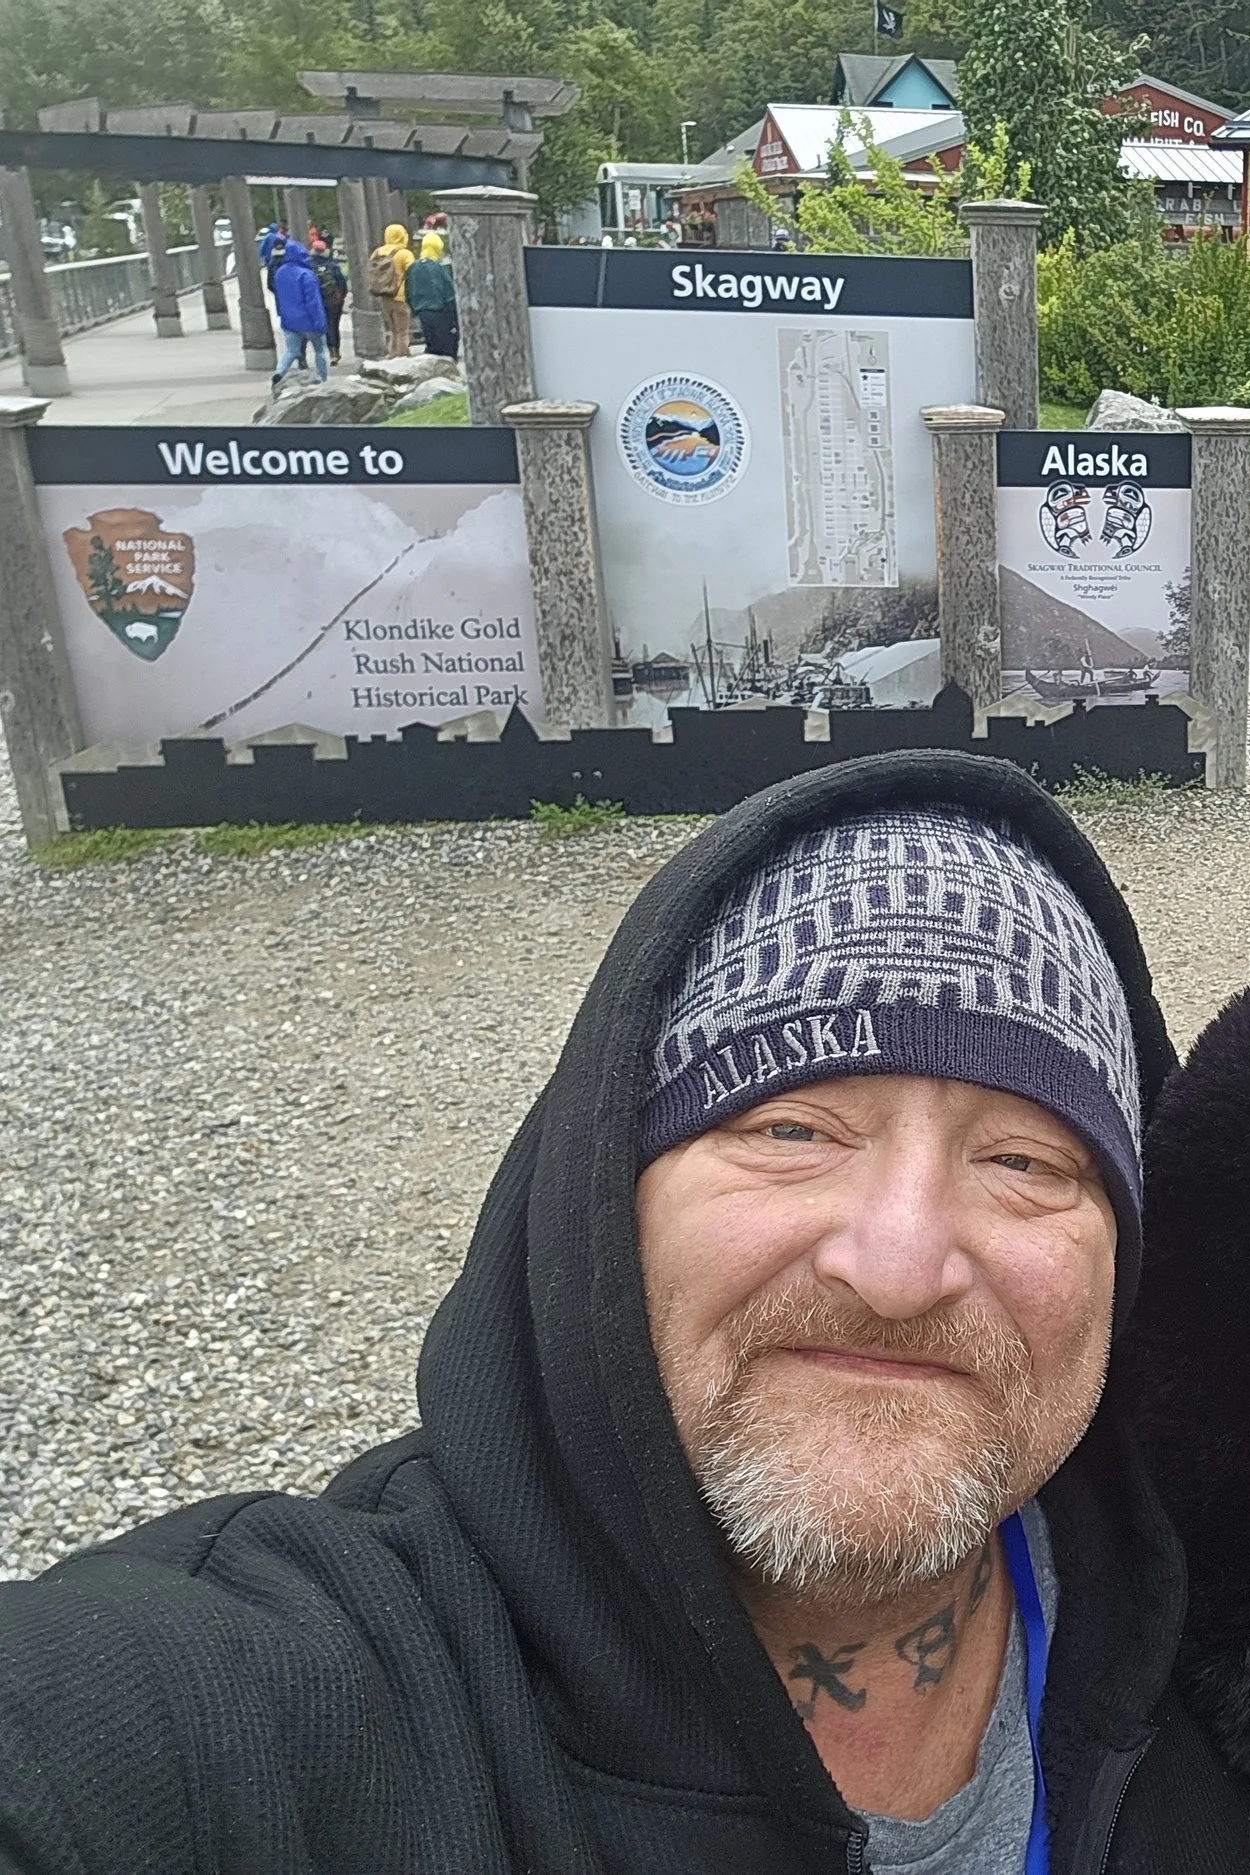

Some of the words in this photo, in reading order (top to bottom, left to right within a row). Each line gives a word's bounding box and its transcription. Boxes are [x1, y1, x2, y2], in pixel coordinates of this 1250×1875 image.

[1150, 109, 1180, 128] FISH
[671, 264, 845, 310] Skagway
[158, 440, 350, 475] Welcome
[359, 445, 404, 475] to
[1041, 444, 1148, 476] Alaska
[115, 540, 186, 551] NATIONAL
[134, 552, 170, 561] PARK
[126, 563, 182, 574] SERVICE
[1027, 563, 1066, 571] SKAGWAY
[1067, 563, 1123, 571] TRADITIONAL
[1125, 563, 1162, 571] COUNCIL
[343, 619, 454, 641] Klondike
[460, 617, 521, 639] Gold
[353, 653, 415, 675] Rush
[421, 651, 525, 673] National
[350, 685, 468, 709] Historical
[474, 684, 529, 706] Park
[700, 1008, 881, 1109] ALASKA
